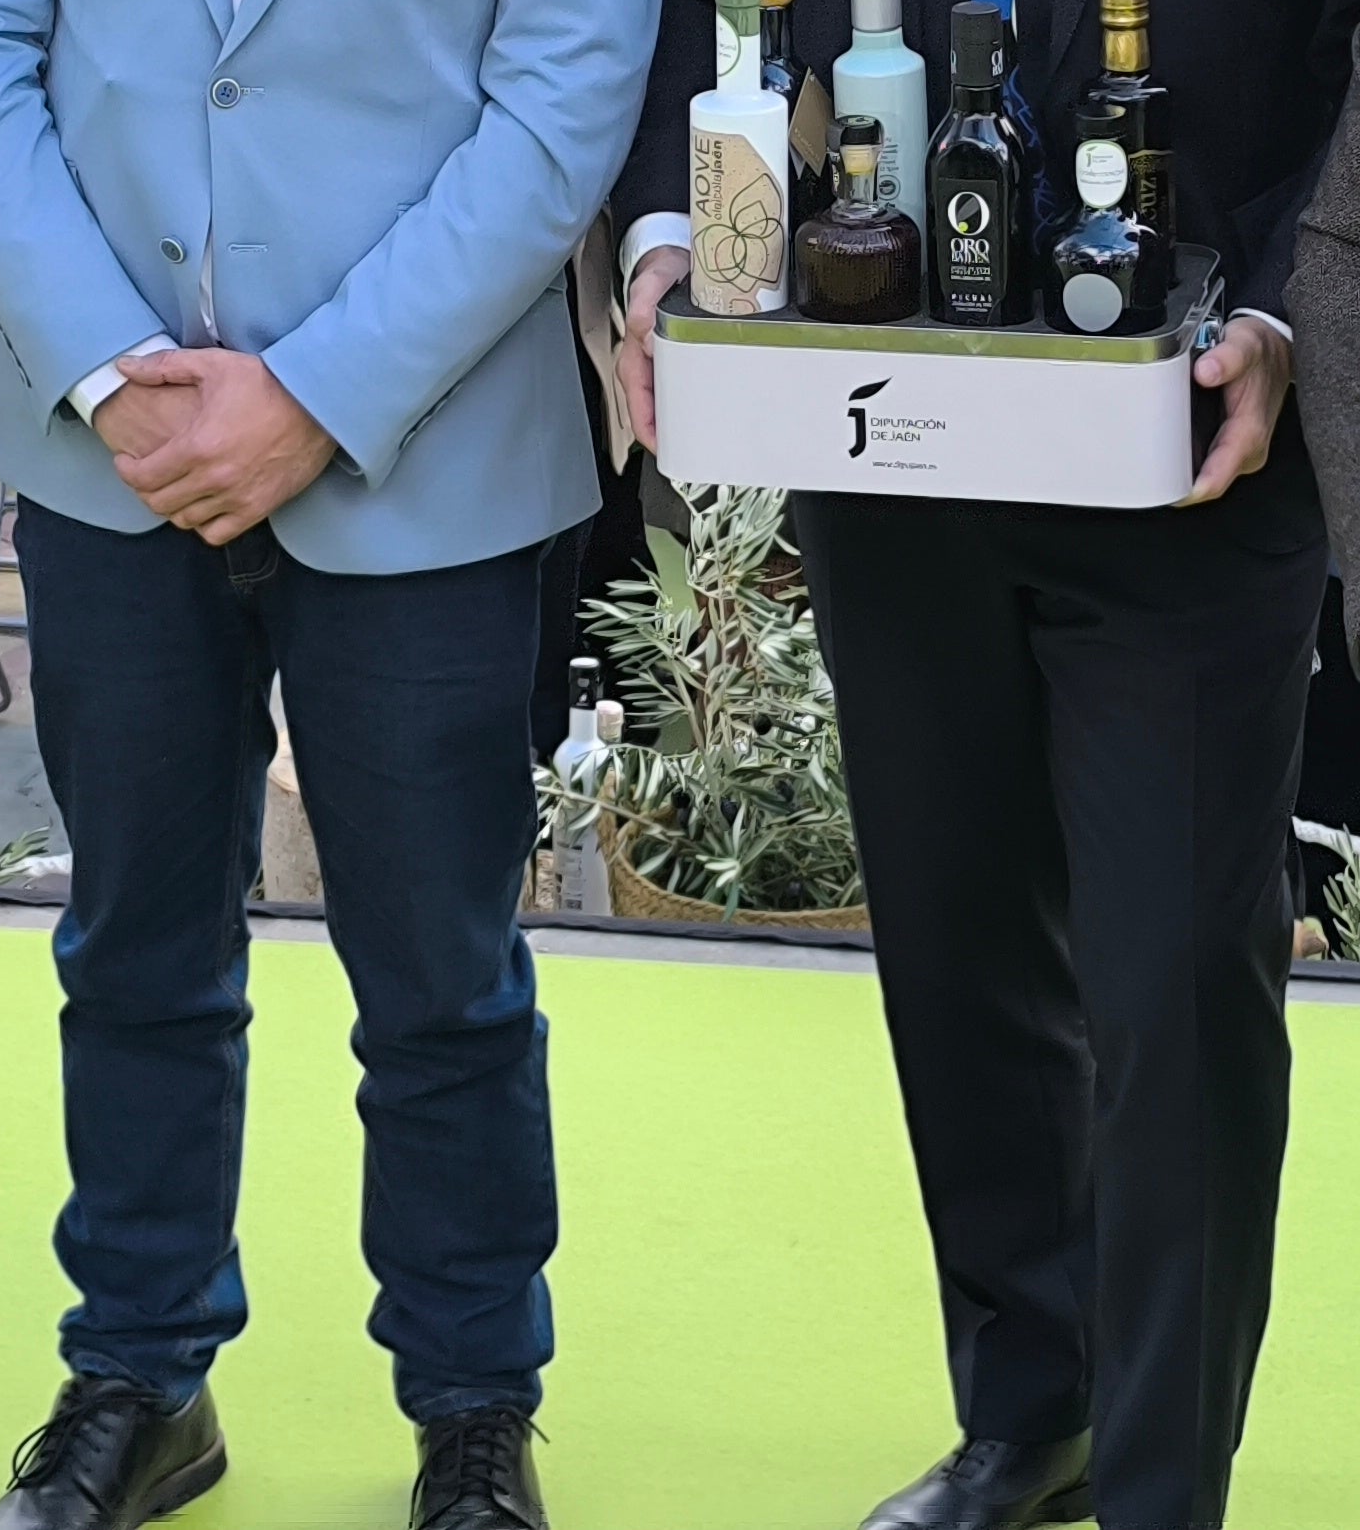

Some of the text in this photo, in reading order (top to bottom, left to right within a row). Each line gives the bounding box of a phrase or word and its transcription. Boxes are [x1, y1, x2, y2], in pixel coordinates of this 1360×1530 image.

[694, 135, 712, 218] AOVE
[870, 417, 946, 430] DIPUTACIÓN
[870, 430, 888, 441] DE
